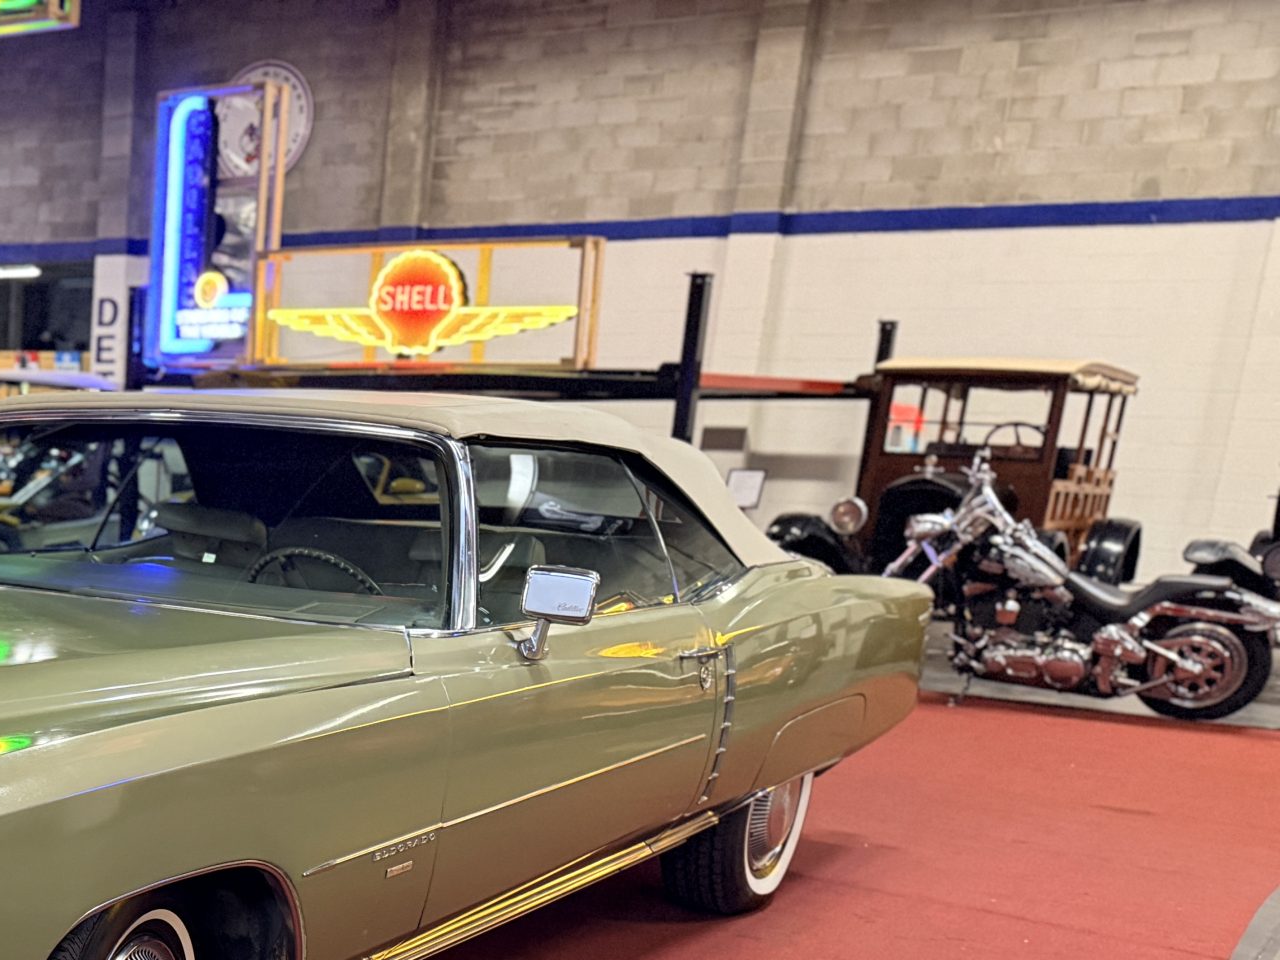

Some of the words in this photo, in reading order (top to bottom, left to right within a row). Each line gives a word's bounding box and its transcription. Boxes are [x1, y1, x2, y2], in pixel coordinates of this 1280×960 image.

[380, 284, 450, 312] SHELL
[94, 298, 119, 379] DE
[372, 832, 436, 862] ELDORADO
